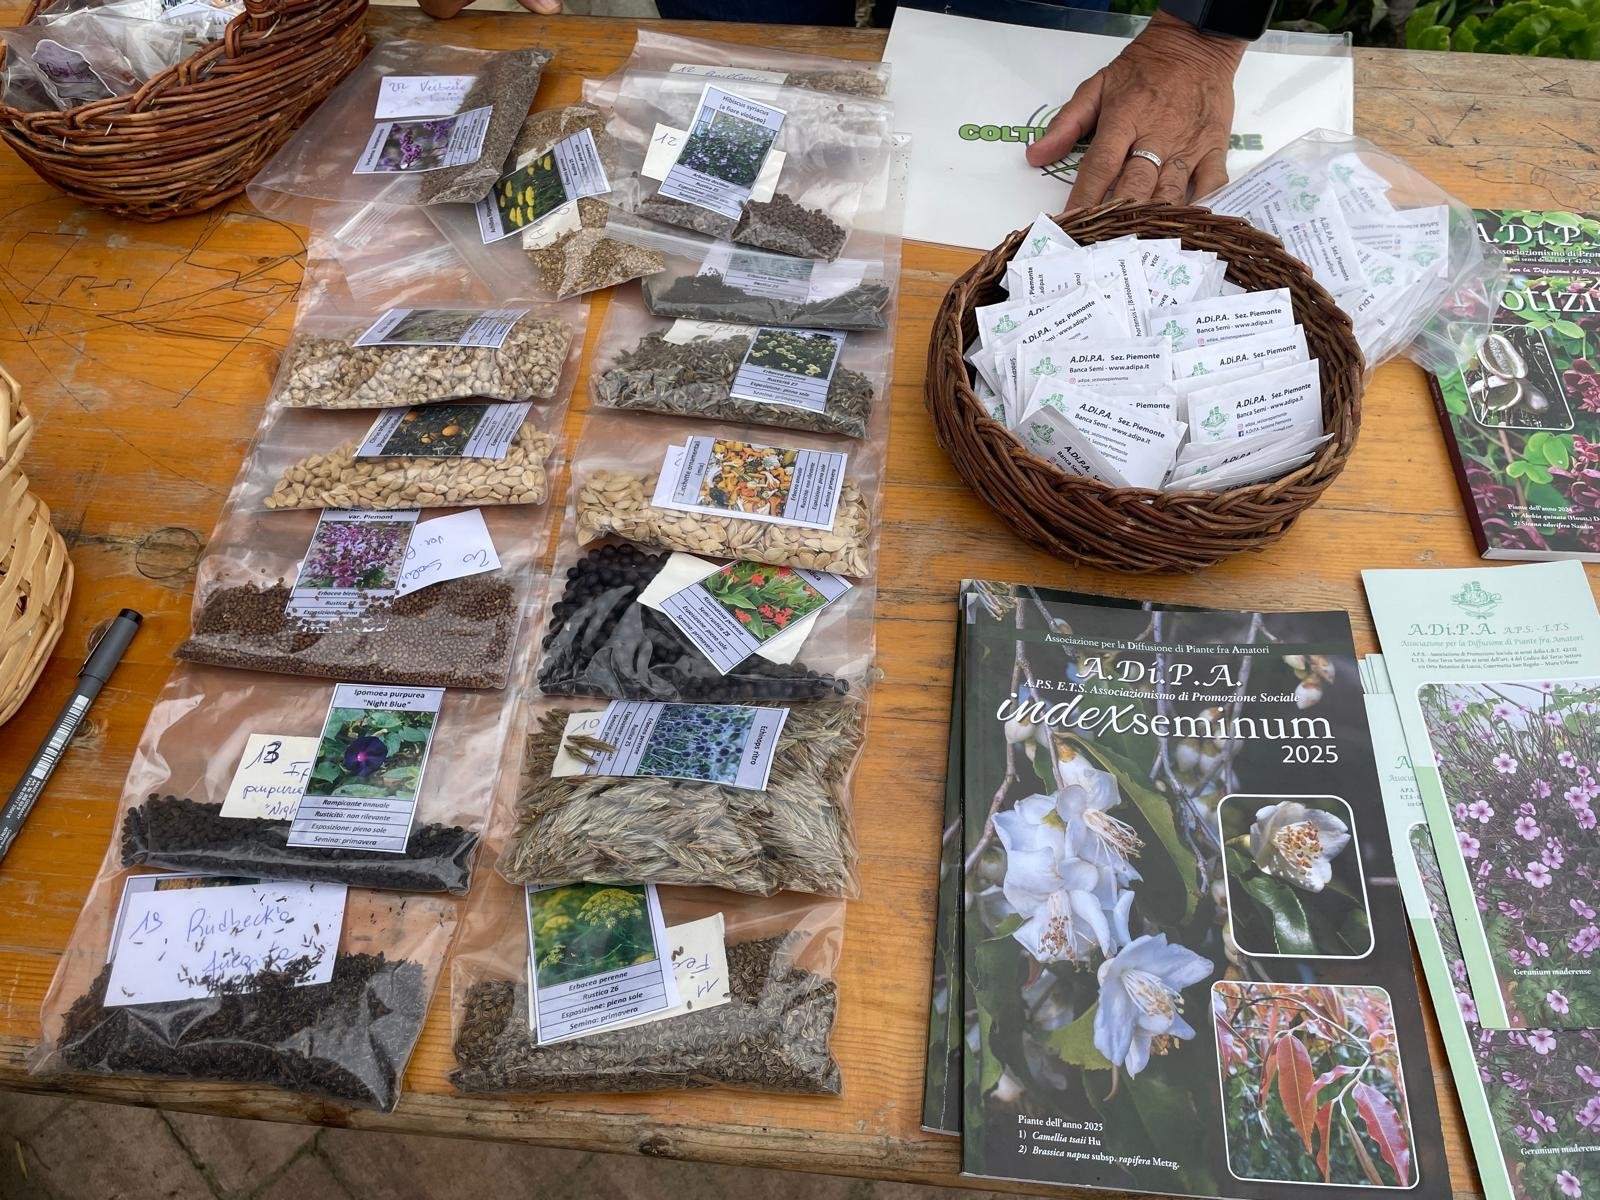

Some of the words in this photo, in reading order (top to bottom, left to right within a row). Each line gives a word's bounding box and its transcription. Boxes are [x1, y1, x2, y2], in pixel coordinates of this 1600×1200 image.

[722, 95, 746, 110] Hibiscus
[746, 103, 769, 117] syriacus
[726, 105, 740, 117] fiore
[1054, 317, 1069, 328] Sez.
[1067, 300, 1096, 320] Piemonte
[1058, 313, 1093, 336] www.adipa.it
[1196, 313, 1230, 325] A.Di.P.A.
[1249, 307, 1282, 318] Piemonte
[1234, 318, 1274, 330] www.adipa.it
[1070, 354, 1105, 364] A.Di.P.A.
[1126, 352, 1161, 360] Piemonte
[1220, 354, 1249, 366] A.Di.P.A.
[1253, 351, 1266, 359] Sez.
[1266, 344, 1297, 356] Piemonte
[1135, 402, 1171, 410] Piemonte
[1236, 394, 1267, 409] A.Di.P.A.
[1271, 391, 1284, 400] Sez.
[1283, 383, 1312, 396] Piemonte
[1236, 410, 1253, 419] Banca
[1253, 407, 1267, 415] Semi
[1270, 395, 1304, 410] www.adipa.it
[1074, 413, 1093, 424] Banca
[1093, 419, 1109, 430] Semi
[1111, 424, 1151, 445] www.adipa.it
[1080, 403, 1113, 420] A.Di.P.A.
[1117, 417, 1132, 427] Sez.
[1132, 421, 1166, 439] Piemonte
[1056, 451, 1072, 465] Banca
[1071, 464, 1084, 477] Semi
[1064, 444, 1091, 473] A.Di.P.A.
[682, 605, 708, 632] Esposizione:
[705, 626, 718, 643] pieno
[703, 596, 727, 622] Rizomatosa
[725, 617, 745, 637] perenne
[676, 614, 693, 632] Semina:
[690, 627, 715, 654] primavera
[1408, 623, 1496, 636] A.Di.P.A.
[1044, 634, 1100, 648] Associazione
[1101, 640, 1115, 650] per
[1116, 641, 1126, 650] la
[1127, 641, 1173, 653] Diffusione
[1174, 644, 1185, 653] di
[1186, 645, 1215, 654] Piante
[1216, 645, 1230, 654] fra
[1231, 645, 1270, 655] Amatori
[1075, 657, 1243, 688] A.Di.P.A.
[354, 688, 388, 699] Ipomoea
[389, 691, 426, 700] purpurea
[1023, 678, 1055, 691] A.P.S.
[1057, 681, 1088, 694] E.T.S.
[1089, 685, 1177, 702] Associazionismo
[1178, 691, 1190, 702] di
[1191, 692, 1258, 704] Promozione
[1259, 692, 1301, 704] Sociale
[754, 724, 769, 749] Echinops
[749, 748, 760, 766] ritro
[1281, 744, 1340, 765] 2025
[322, 799, 362, 808] Rampicante
[360, 813, 391, 822] rilevante
[311, 823, 351, 833] Esposizione:
[352, 825, 370, 834] pieno
[371, 826, 387, 834] sole
[313, 835, 341, 844] Semina:
[342, 837, 378, 847] primavera
[569, 977, 598, 991] Erbacea
[598, 971, 629, 984] perenne
[1513, 968, 1550, 977] Geranium
[1552, 967, 1592, 976] maderense
[561, 1002, 606, 1019] Esposizione:
[606, 997, 628, 1010] pieno
[628, 991, 644, 1003] sole
[569, 1017, 599, 1030] Semina:
[600, 1006, 639, 1024] primavera
[1018, 1115, 1044, 1127] Piante
[1084, 1122, 1104, 1132] 2025
[1018, 1129, 1027, 1140] 1)
[1032, 1131, 1068, 1143] Camellia
[1069, 1135, 1087, 1145] tsaii
[1088, 1138, 1102, 1146] Hu
[1018, 1145, 1028, 1155] 2)
[1032, 1145, 1065, 1158] Brassica
[1066, 1151, 1091, 1162] napus
[1091, 1152, 1118, 1165] subsp.
[1118, 1156, 1151, 1168] rapifera
[1151, 1157, 1180, 1170] Metzg.
[1520, 1146, 1560, 1156] Geranium
